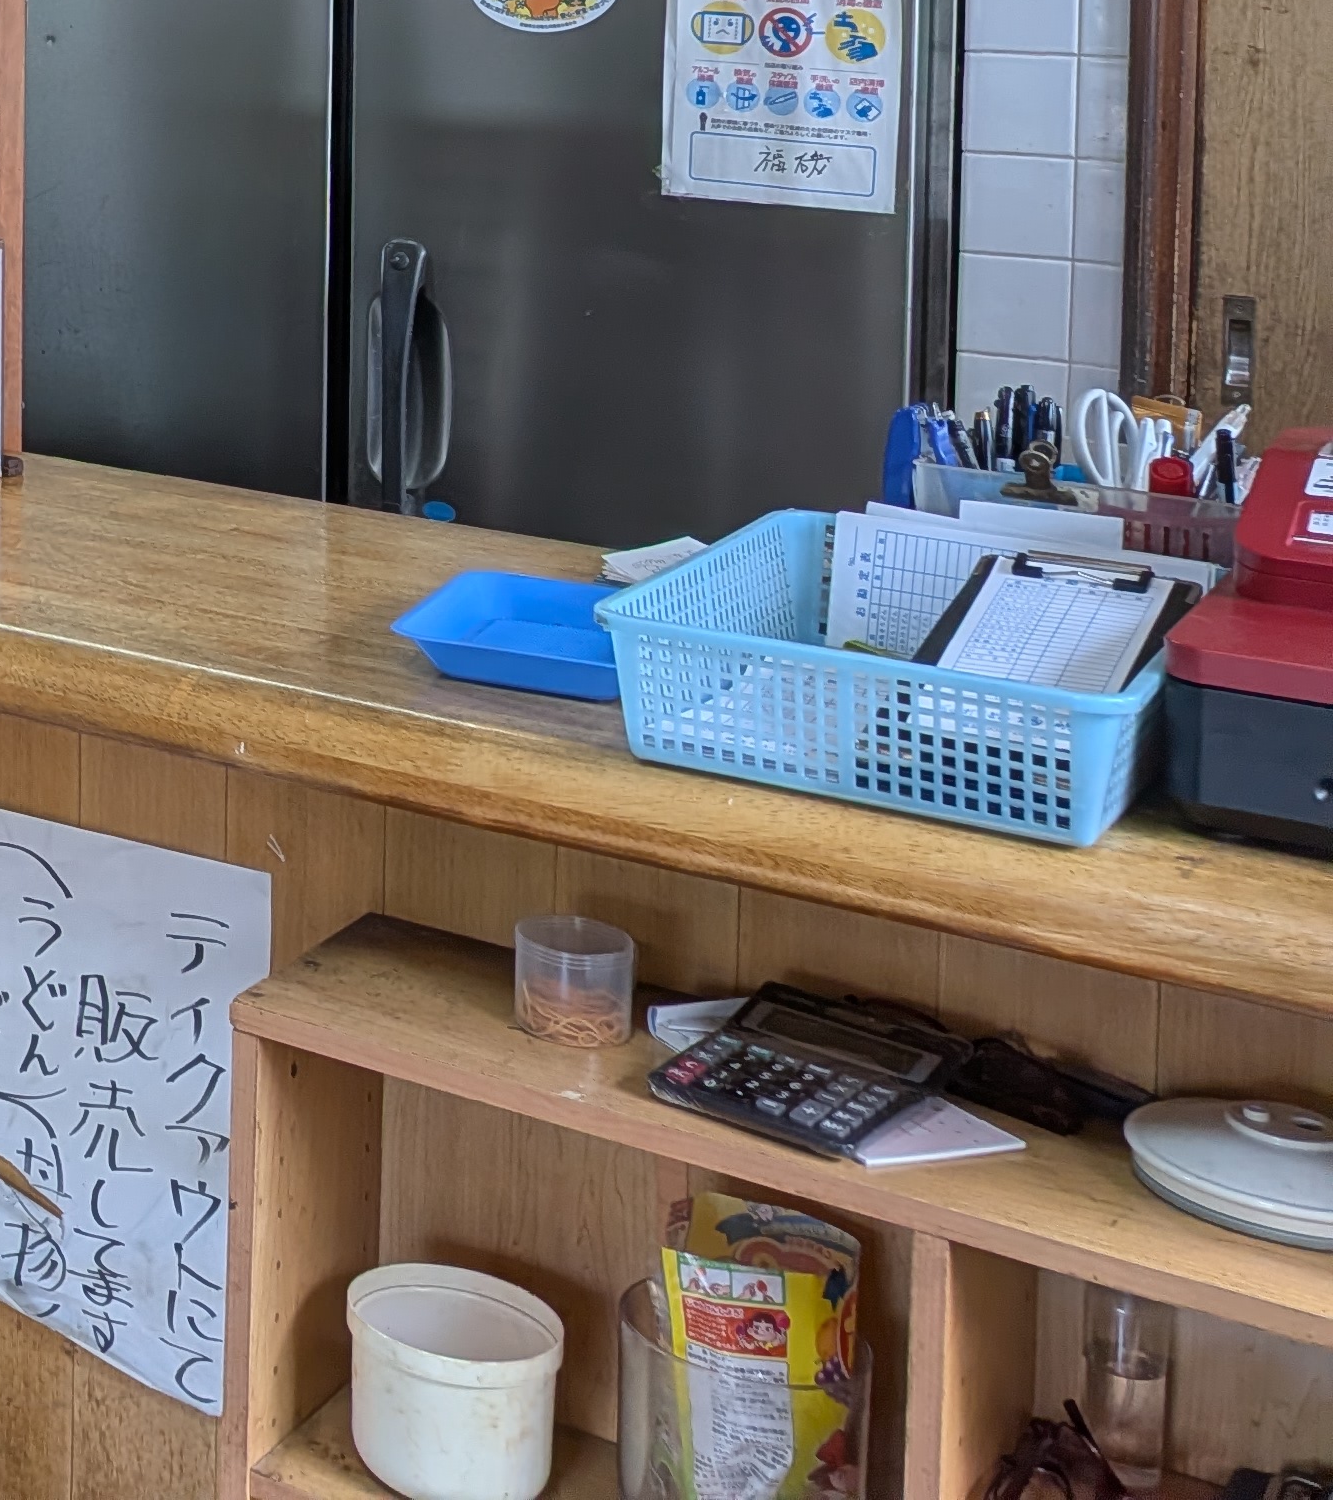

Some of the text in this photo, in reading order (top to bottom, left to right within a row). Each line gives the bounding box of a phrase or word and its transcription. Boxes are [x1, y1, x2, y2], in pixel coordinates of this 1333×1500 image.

[18, 896, 69, 1076] うどん
[68, 974, 158, 1354] 販売してます
